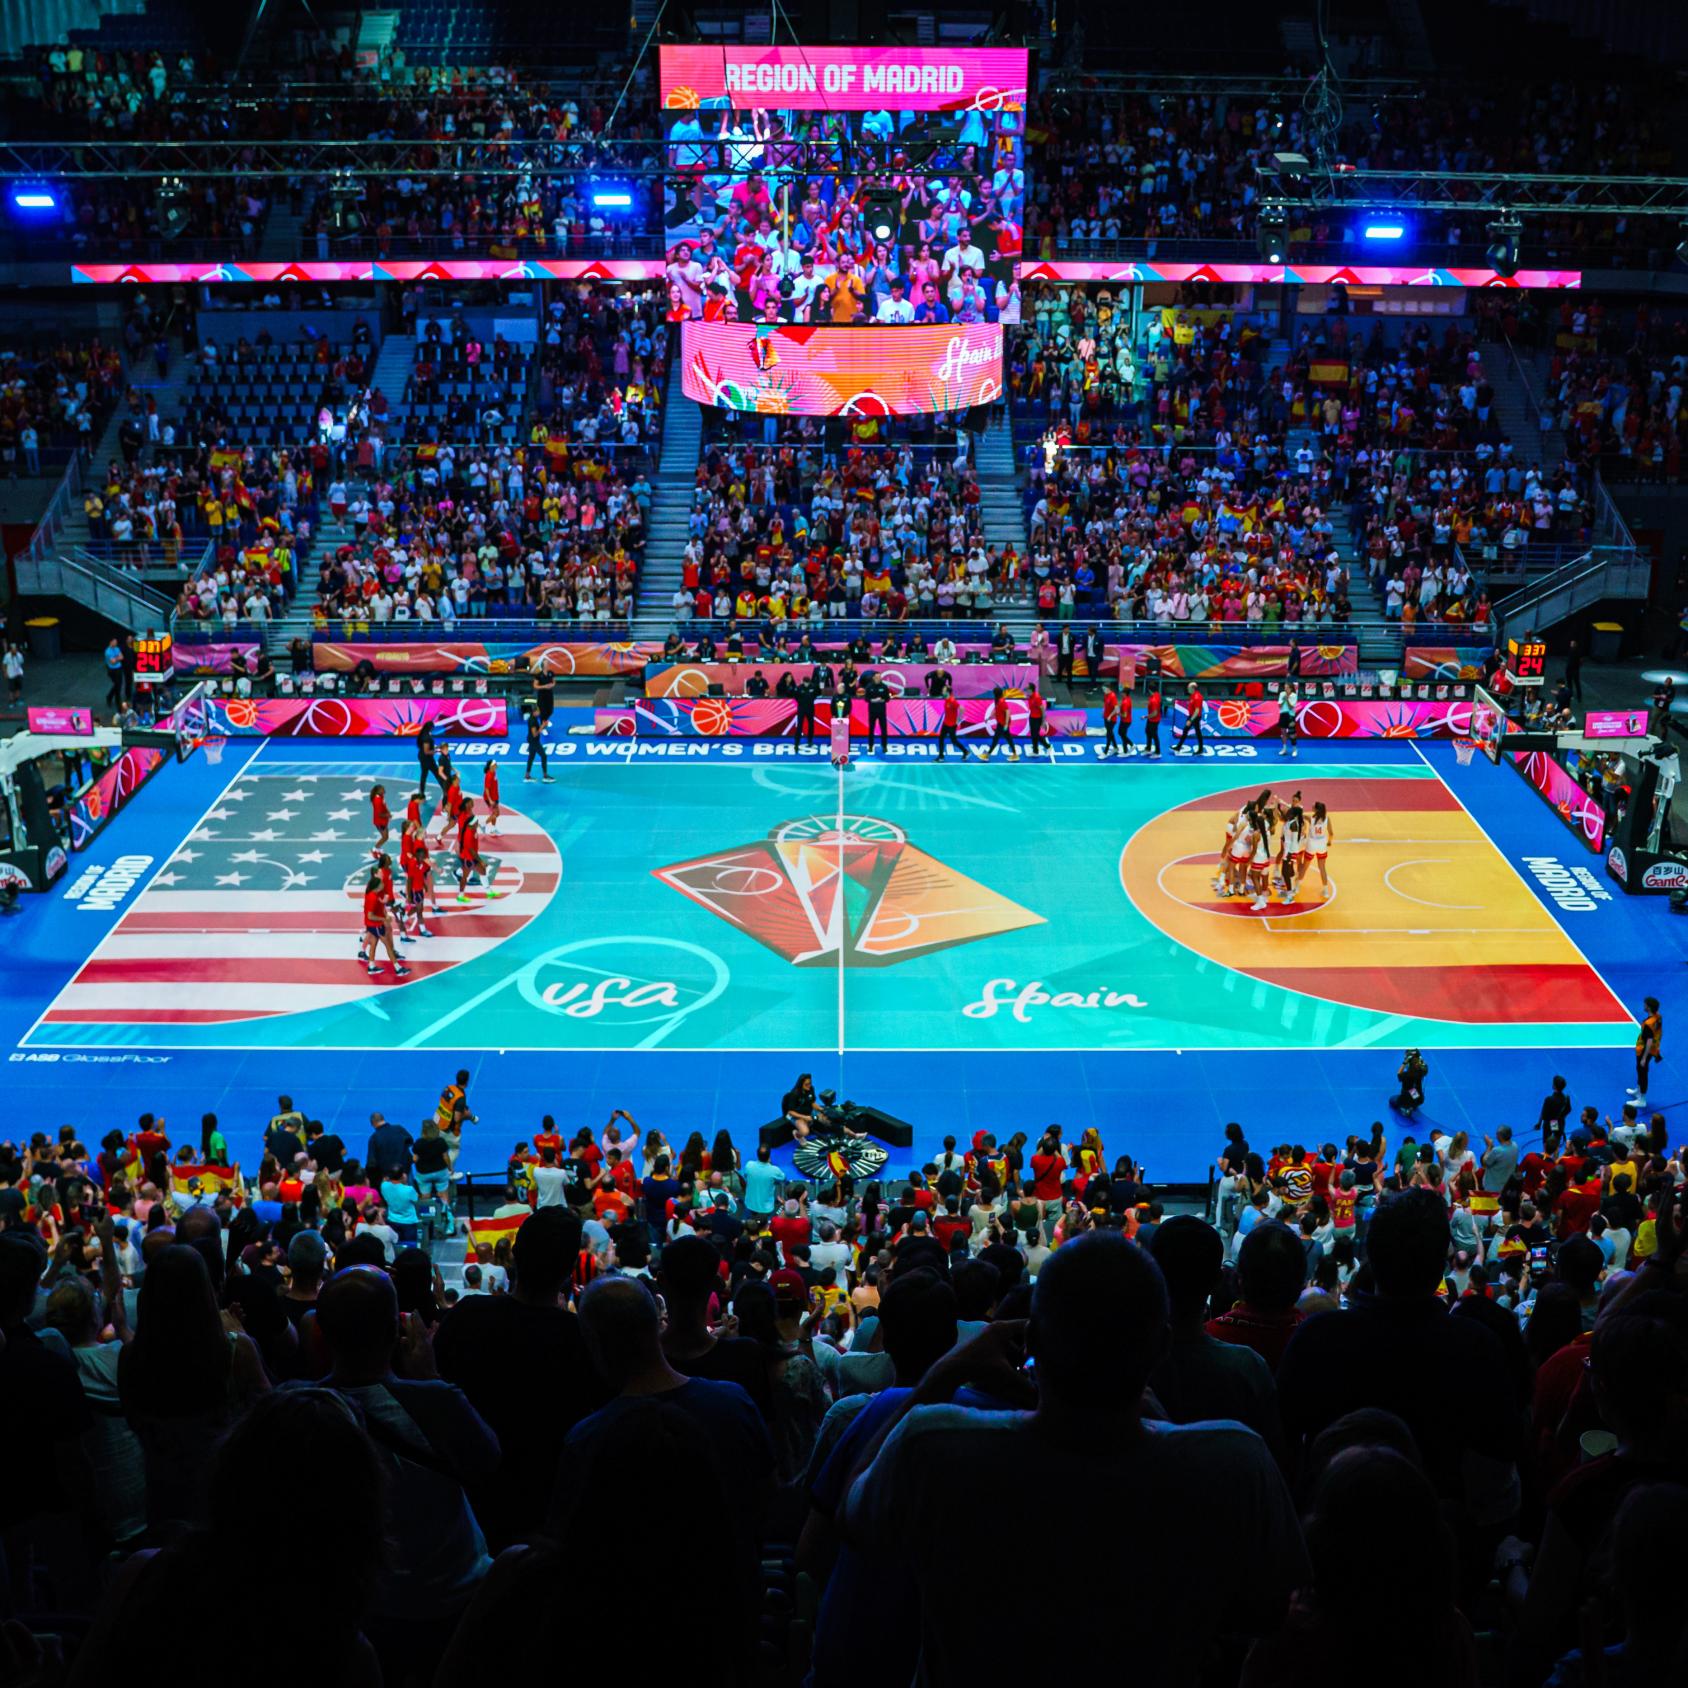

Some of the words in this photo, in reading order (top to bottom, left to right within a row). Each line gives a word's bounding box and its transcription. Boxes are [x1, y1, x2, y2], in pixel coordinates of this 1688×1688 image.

[725, 63, 816, 92] REGION
[823, 64, 857, 92] OF
[863, 64, 964, 93] MADRID
[137, 653, 160, 672] 24
[1518, 657, 1543, 676] 24
[586, 743, 743, 756] WOMEN'S
[76, 855, 154, 910] MADRID
[1521, 857, 1598, 911] MADRID
[962, 978, 1149, 1023] Spain
